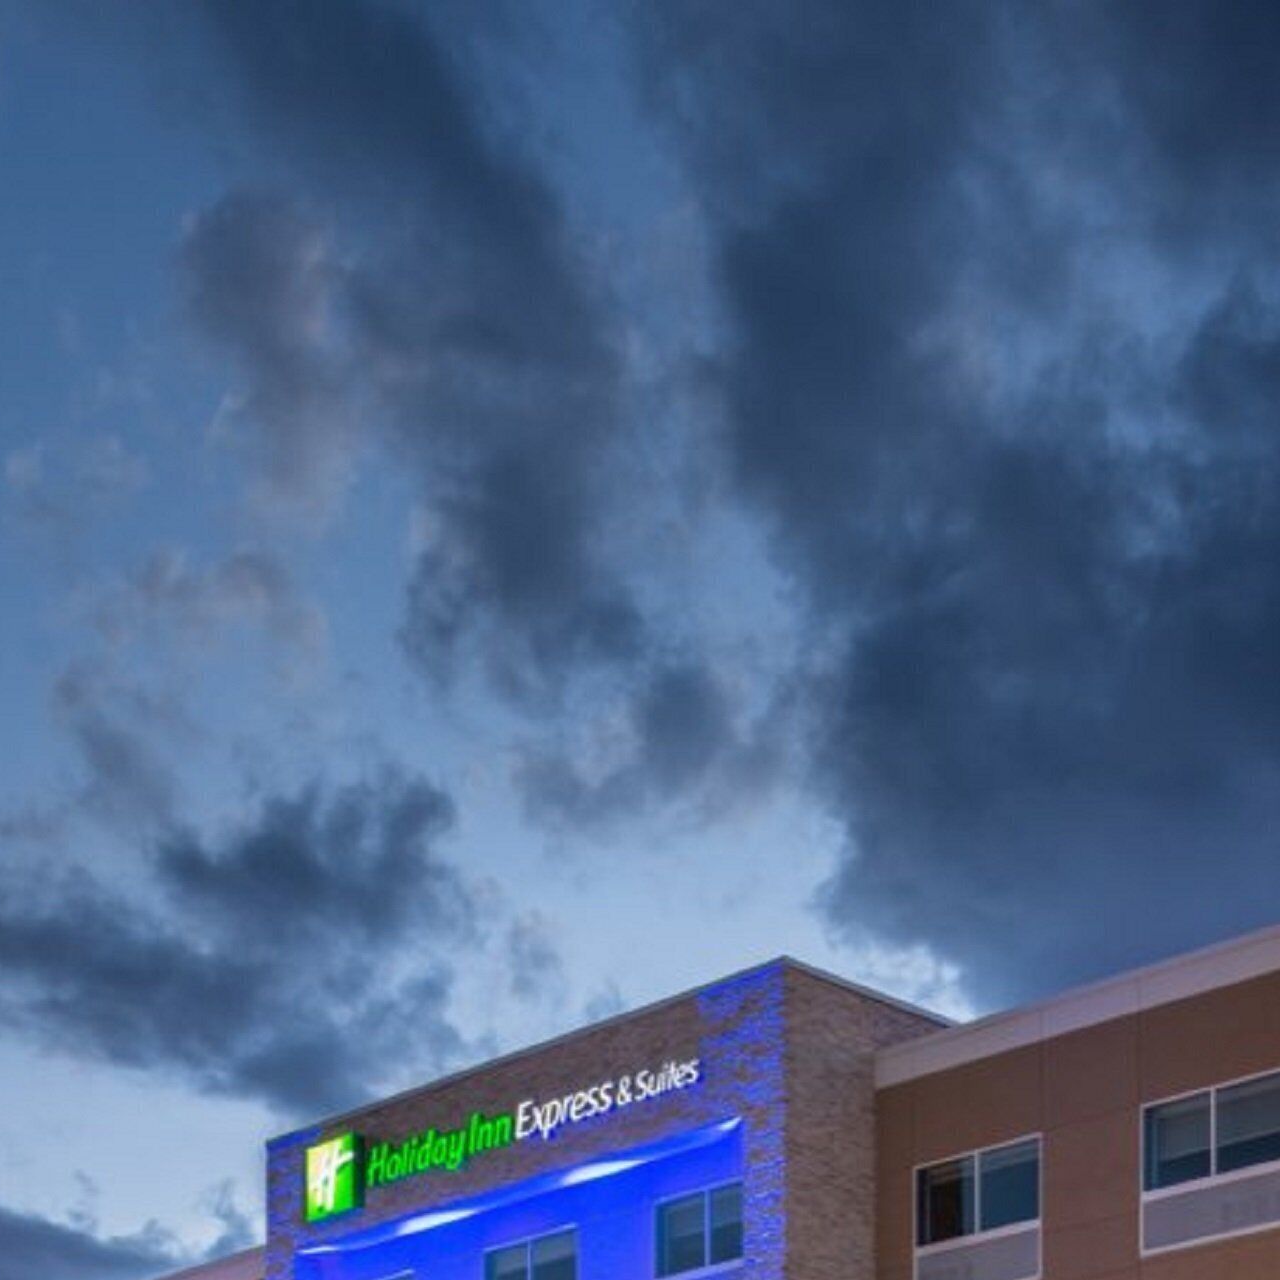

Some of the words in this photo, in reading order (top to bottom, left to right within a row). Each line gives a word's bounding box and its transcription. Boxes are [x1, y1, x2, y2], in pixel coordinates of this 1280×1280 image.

[367, 1129, 467, 1188] Holiday
[469, 1112, 513, 1155] Inn
[515, 1081, 613, 1140] Express
[617, 1074, 632, 1106] &
[633, 1058, 700, 1101] Suites
